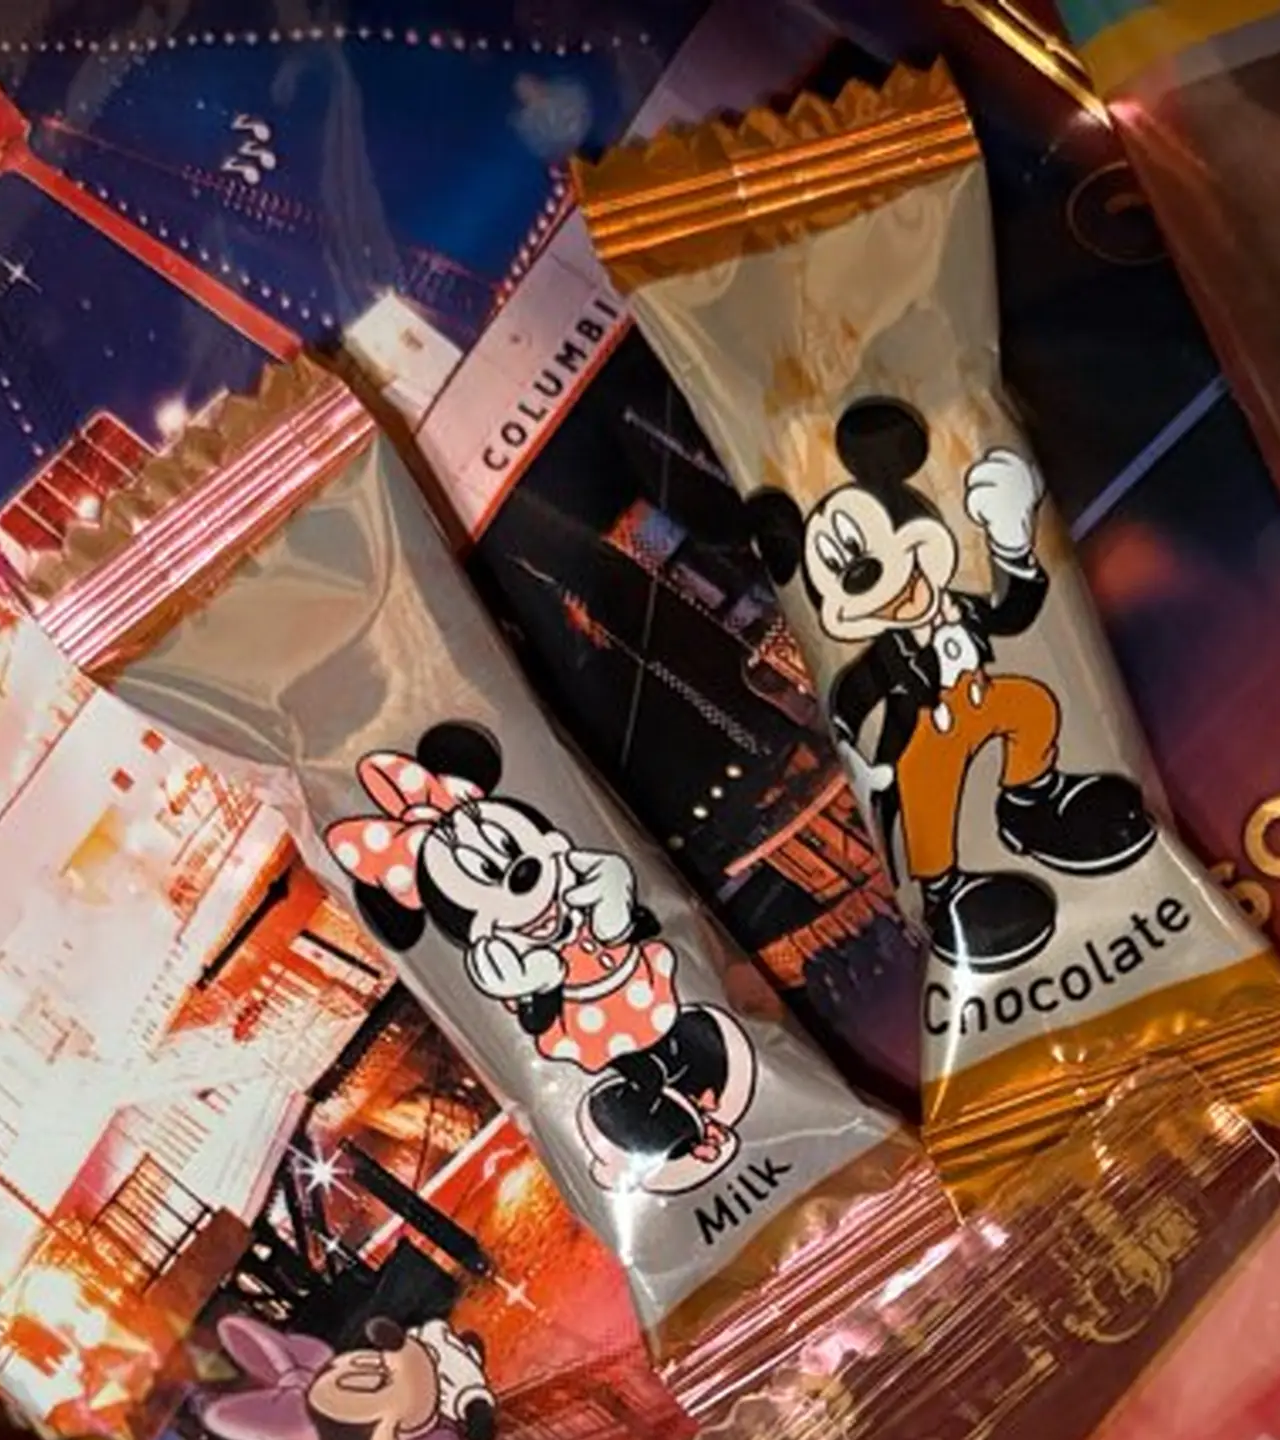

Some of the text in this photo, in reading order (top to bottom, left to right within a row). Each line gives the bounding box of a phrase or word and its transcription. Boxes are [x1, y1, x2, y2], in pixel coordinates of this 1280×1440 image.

[482, 299, 618, 471] COLUMBI
[923, 897, 1191, 1036] Chocolate
[694, 1154, 792, 1246] Milk
